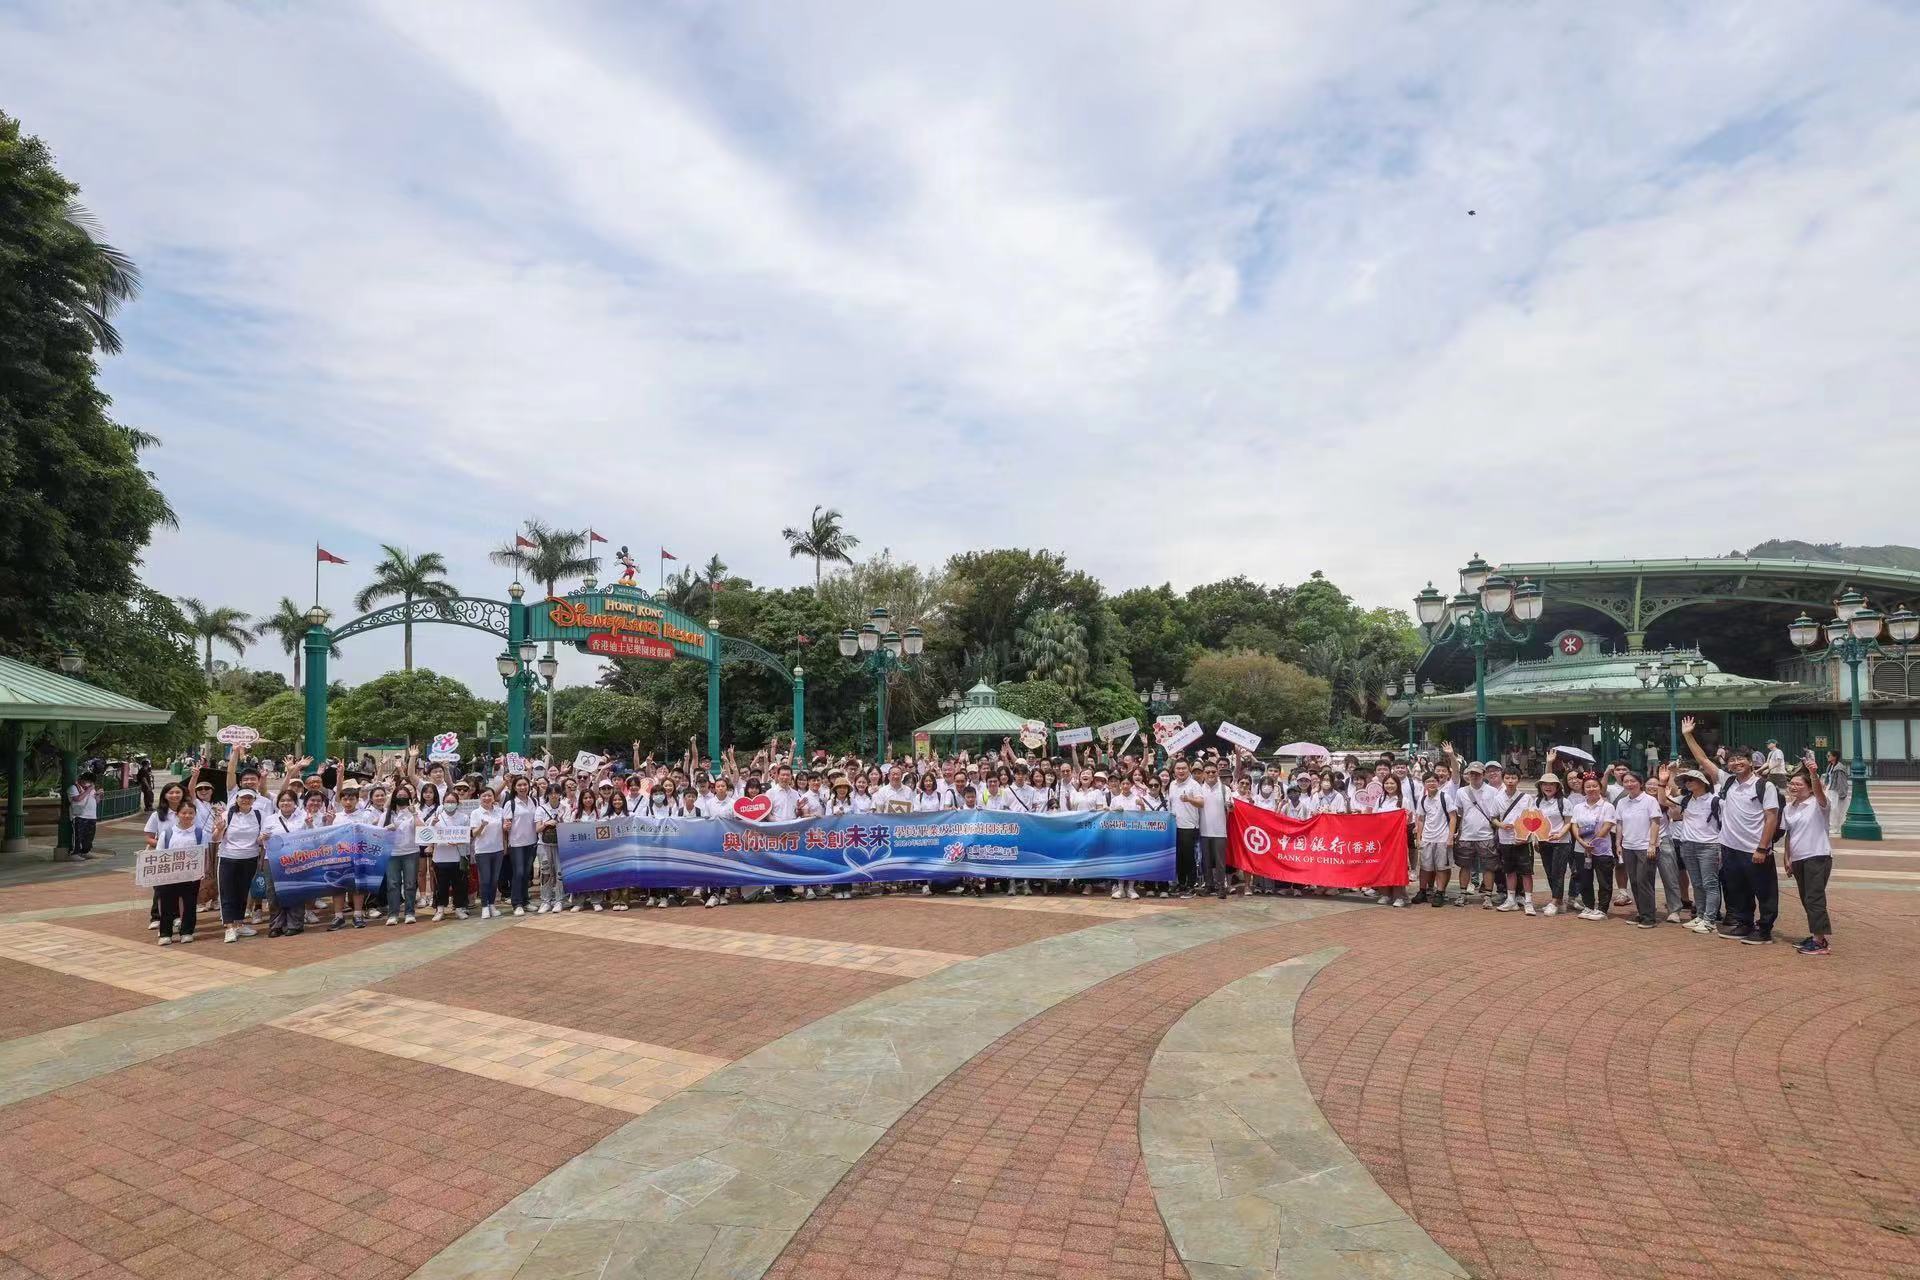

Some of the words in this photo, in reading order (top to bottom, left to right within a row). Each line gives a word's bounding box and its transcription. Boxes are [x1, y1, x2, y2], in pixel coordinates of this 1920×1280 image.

[605, 599, 636, 613] HONG
[636, 605, 663, 619] KONG
[662, 621, 705, 648] Resort
[591, 639, 672, 658] 香港迪士尼樂園度假區
[722, 829, 800, 851] 與你同行
[805, 824, 890, 850] 共創未來
[145, 851, 186, 865] 中企關
[1277, 853, 1301, 862] BANK
[1317, 857, 1345, 865] CHINA
[143, 860, 199, 877] 同路同行
